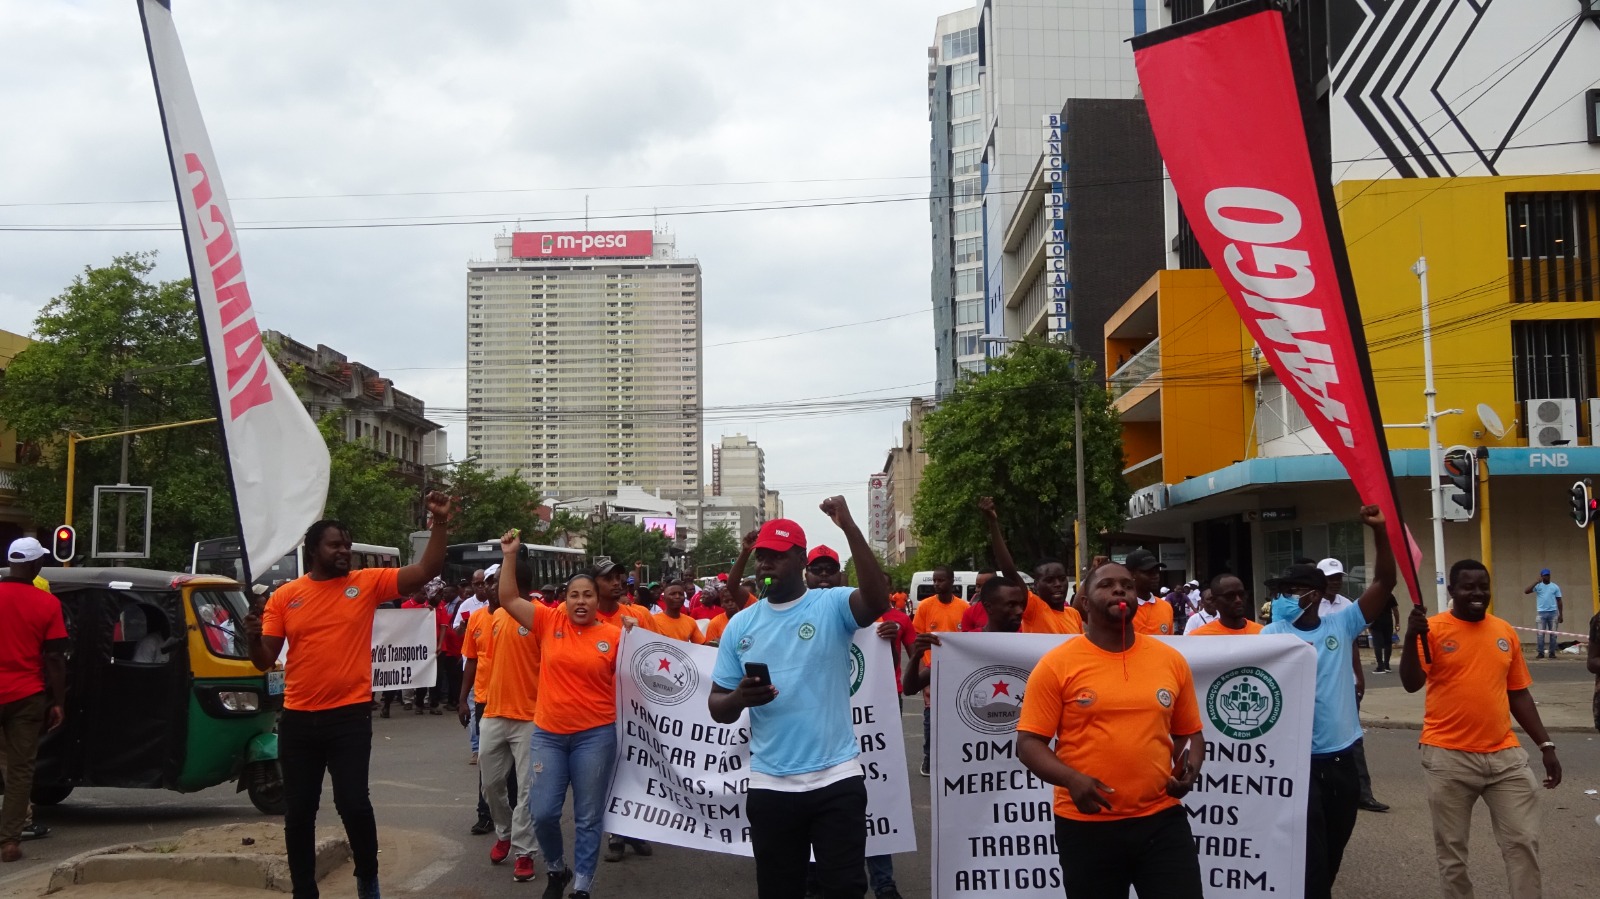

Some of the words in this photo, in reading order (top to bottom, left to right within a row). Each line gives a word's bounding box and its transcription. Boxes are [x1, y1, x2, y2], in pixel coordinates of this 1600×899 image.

[1049, 115, 1062, 183] BANCO
[1051, 193, 1062, 219] DE
[557, 234, 627, 253] m-pesa
[1529, 453, 1569, 468] FNB
[388, 644, 428, 663] Transporte
[372, 668, 400, 687] Maputo
[401, 667, 412, 684] E.P.
[1208, 681, 1222, 720] Associação
[1221, 671, 1240, 682] Rede
[1255, 669, 1277, 691] Direitos
[1268, 690, 1281, 723] Humanos
[630, 699, 684, 737] YANGO
[852, 705, 876, 725] DE
[987, 710, 1016, 719] SINTRAT
[627, 720, 696, 769] COLOCAR
[704, 751, 742, 774] PÃO
[856, 732, 886, 753] AS
[962, 739, 1019, 763] SOM
[723, 777, 750, 795] NO
[944, 769, 1045, 797] MERECE
[646, 777, 694, 810] ESTES
[697, 803, 740, 820] TEM
[608, 796, 697, 834] ESTUDAR
[703, 822, 713, 839] E
[720, 828, 732, 843] A
[742, 826, 752, 843] A
[993, 801, 1052, 824] IGUA
[955, 867, 1061, 892] ARTIGOS
[1209, 867, 1275, 892] CRM.
